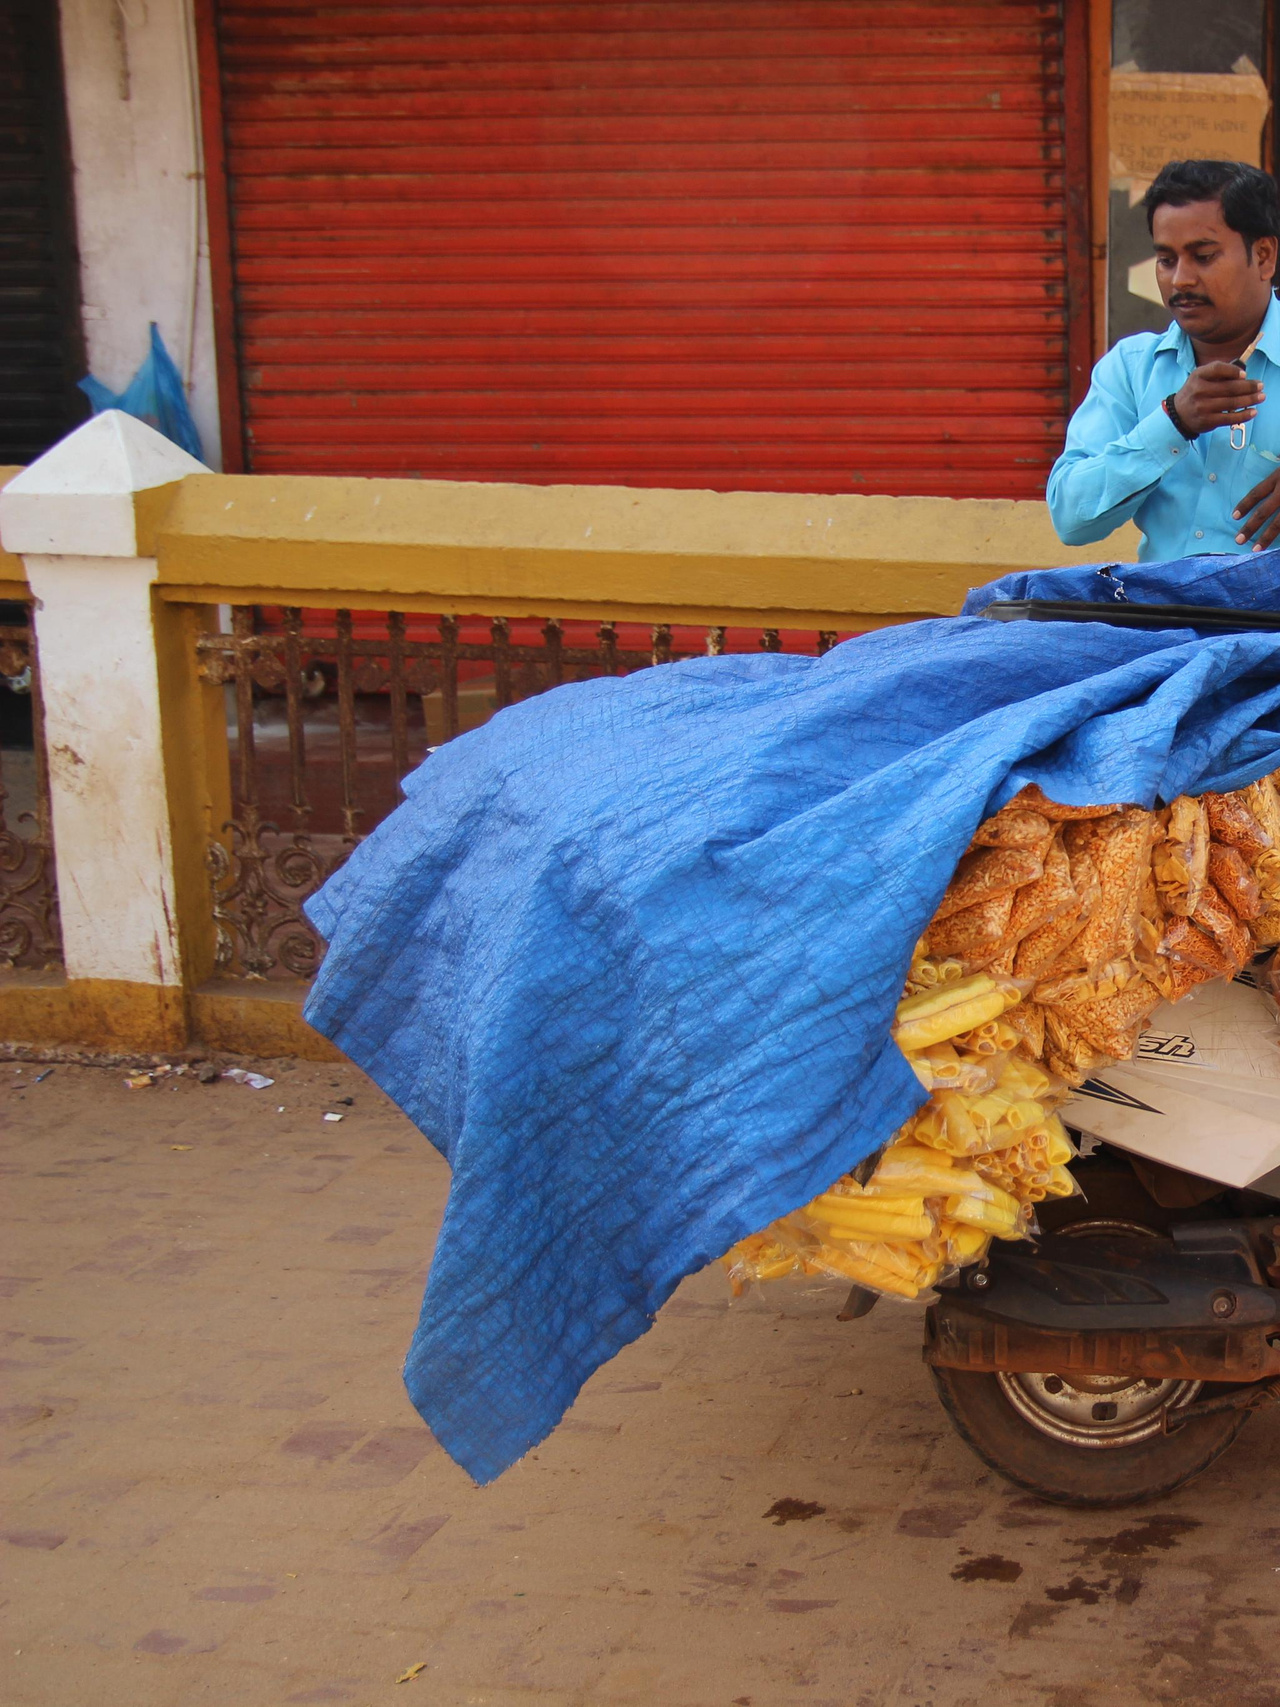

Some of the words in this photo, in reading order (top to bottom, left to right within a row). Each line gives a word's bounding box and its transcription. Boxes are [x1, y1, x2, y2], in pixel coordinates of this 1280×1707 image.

[1113, 112, 1158, 128] FRONT
[1162, 115, 1184, 129] OF
[1185, 115, 1209, 132] THE
[1159, 130, 1192, 142] SHOP
[1118, 143, 1136, 158] IS
[1141, 146, 1164, 158] NOT
